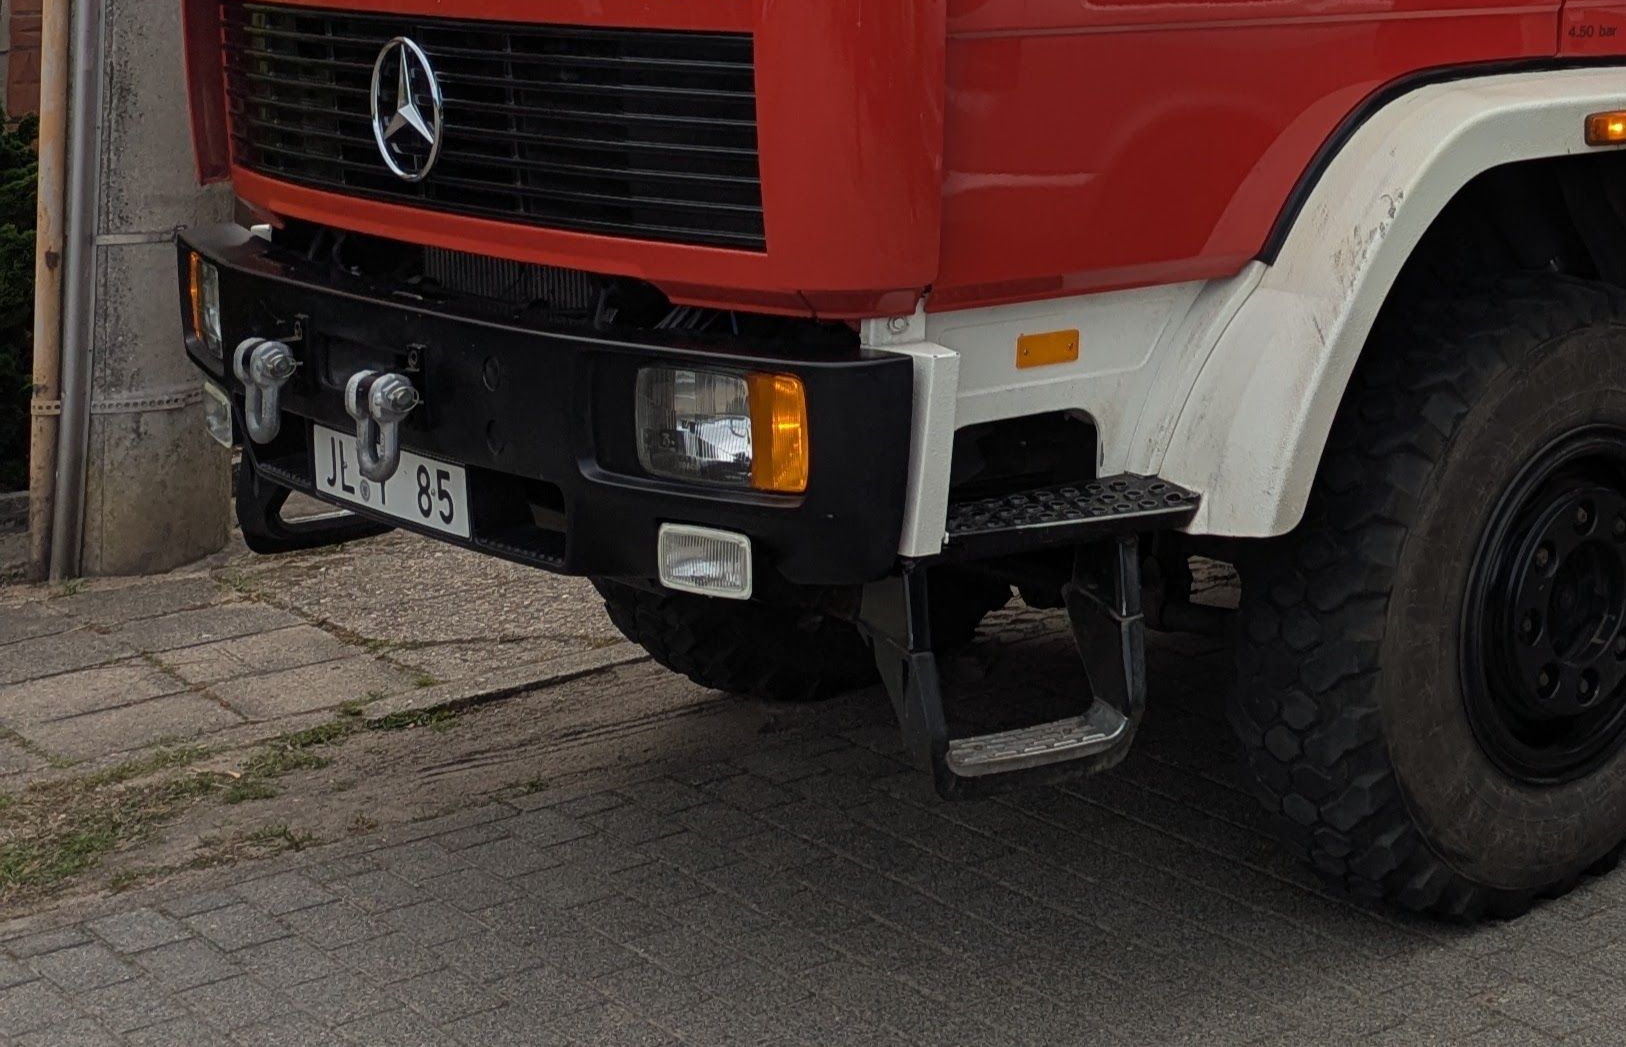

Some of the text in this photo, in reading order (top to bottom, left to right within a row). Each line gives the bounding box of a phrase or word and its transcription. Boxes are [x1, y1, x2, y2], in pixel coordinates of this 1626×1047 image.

[1568, 24, 1617, 38] 4.50 bar
[326, 436, 355, 495] JL
[416, 464, 455, 525] 85
